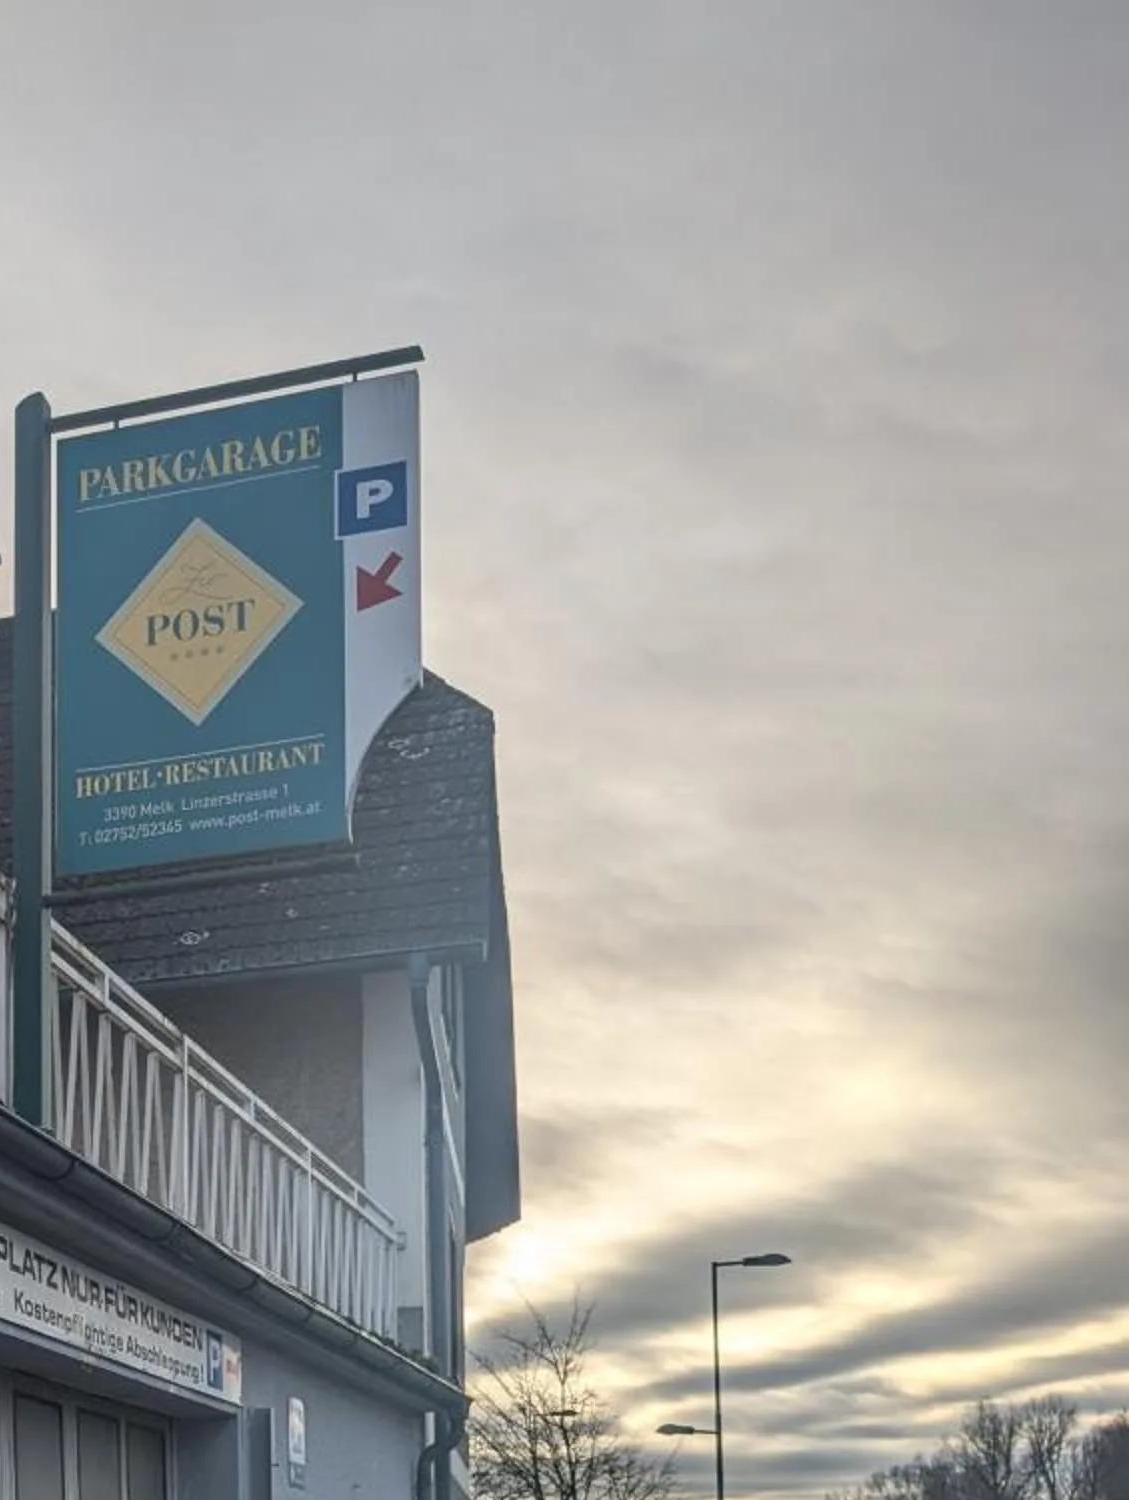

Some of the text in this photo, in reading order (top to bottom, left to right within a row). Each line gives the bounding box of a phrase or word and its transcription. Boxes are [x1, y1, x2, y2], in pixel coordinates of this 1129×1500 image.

[79, 426, 322, 502] PARKGARAGE
[356, 479, 394, 519] P
[146, 600, 255, 646] POST
[103, 783, 289, 822] 3390 Melk Linzerstrasse 1
[189, 800, 322, 831] www.post-melk.at
[61, 1265, 102, 1310] NUR
[104, 1282, 138, 1325] FÜR
[141, 1301, 203, 1351] KUNDEN
[210, 1336, 220, 1384] P
